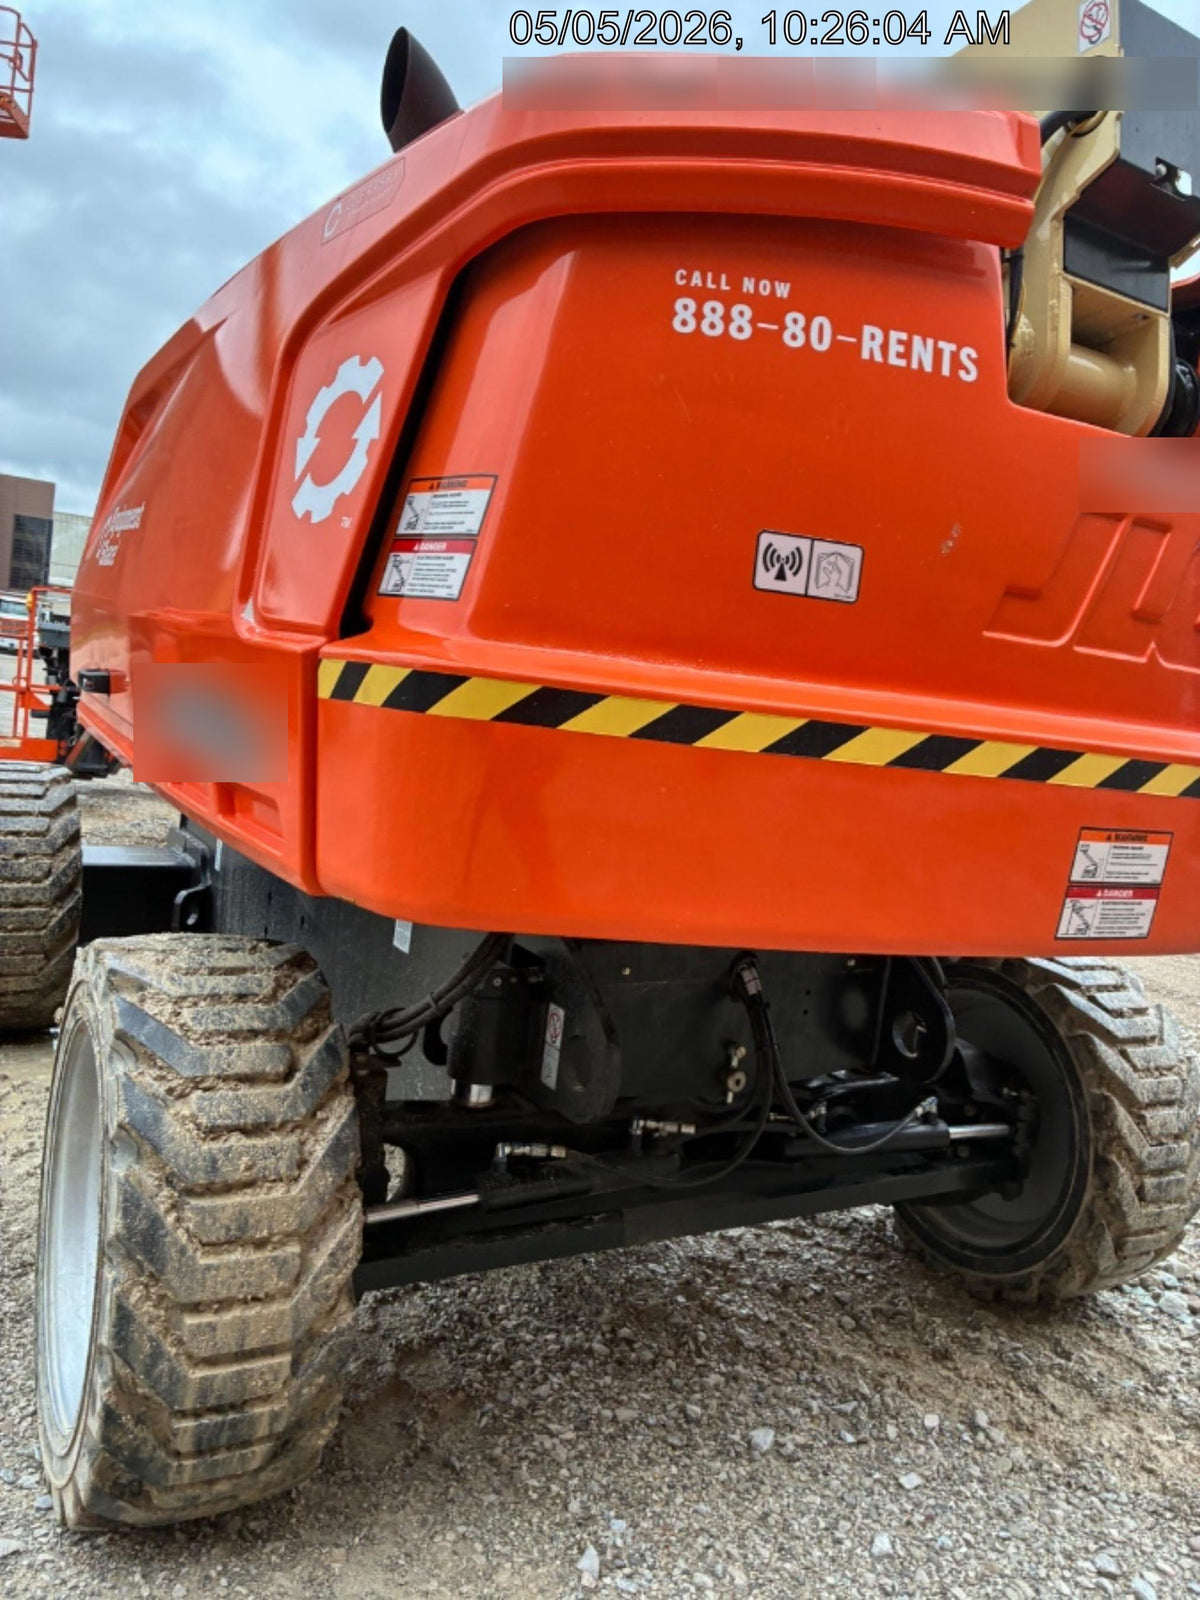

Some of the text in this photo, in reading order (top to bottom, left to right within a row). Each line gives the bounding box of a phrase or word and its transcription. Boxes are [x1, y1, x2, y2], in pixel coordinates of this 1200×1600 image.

[674, 269, 792, 299] CALL NOW
[671, 297, 979, 383] 888-80-RENTS
